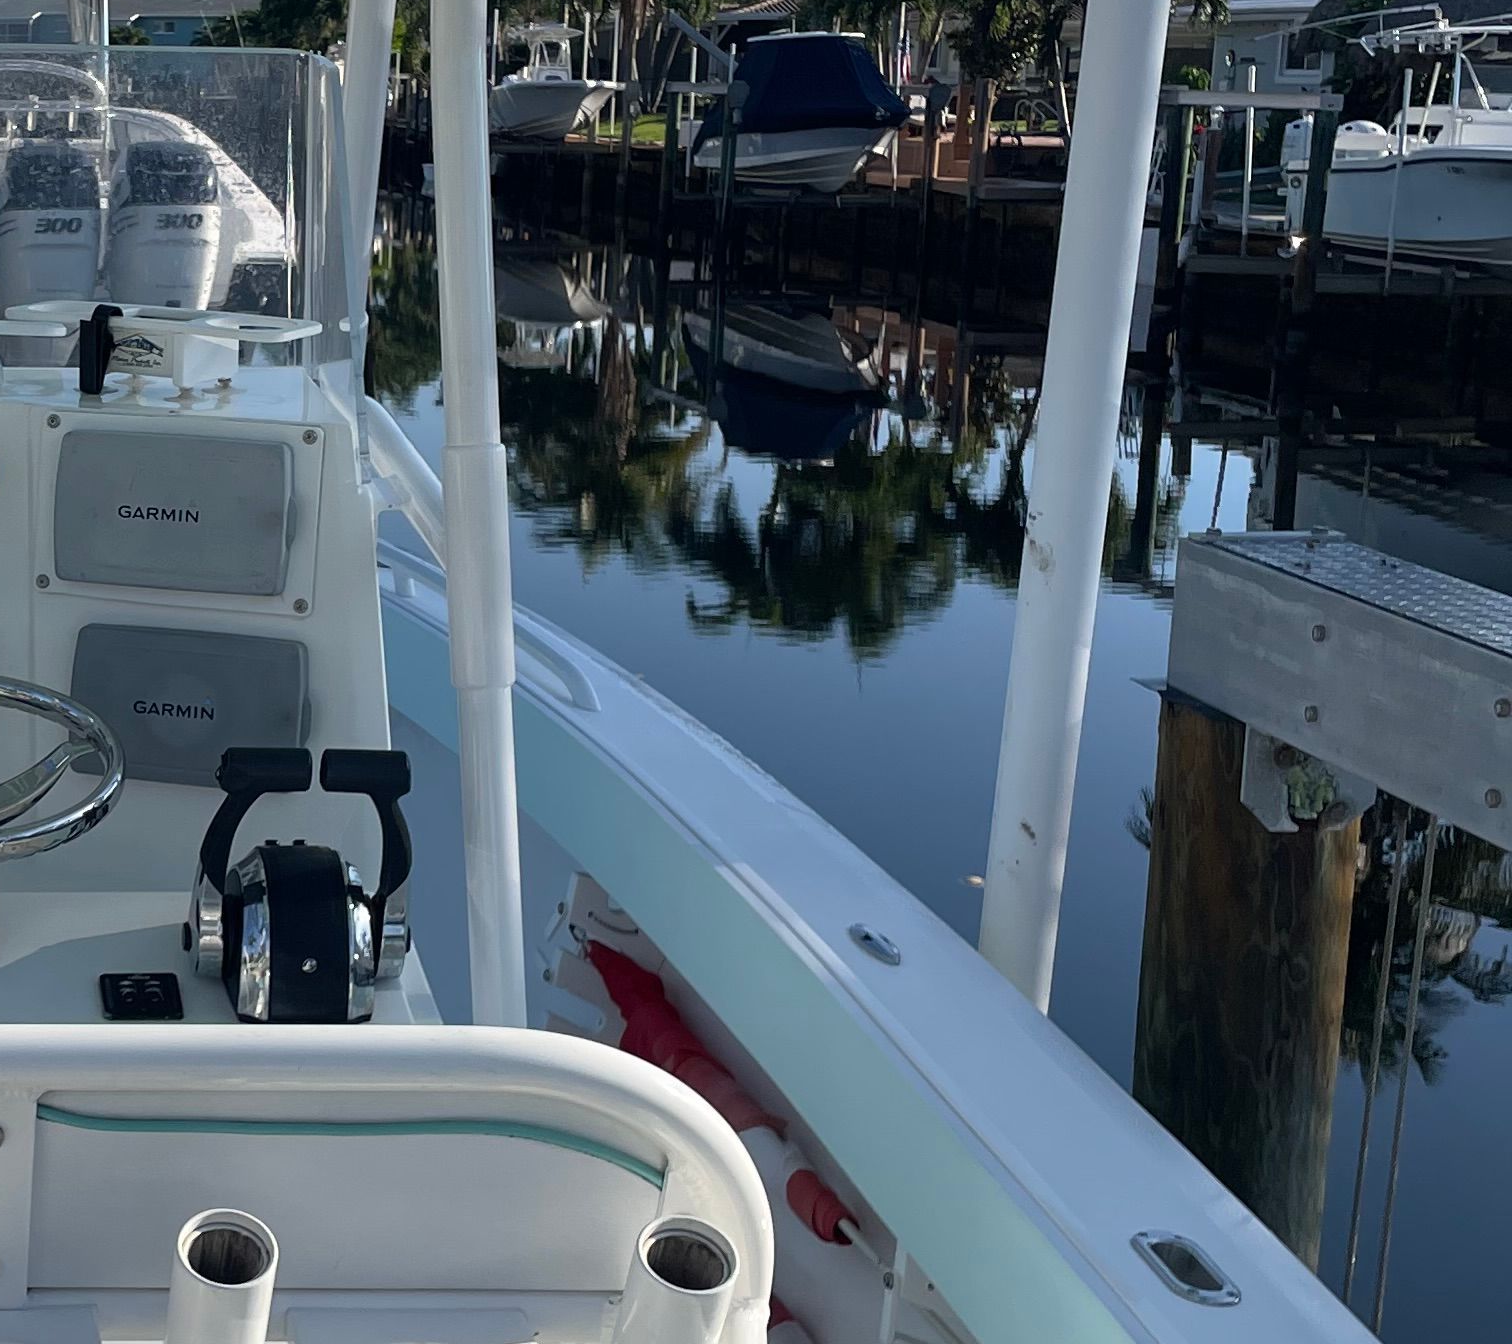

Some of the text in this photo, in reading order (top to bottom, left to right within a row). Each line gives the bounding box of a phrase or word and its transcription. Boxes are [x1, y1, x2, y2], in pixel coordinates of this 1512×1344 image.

[34, 216, 82, 234] 300
[155, 212, 203, 230] 300
[118, 505, 200, 523] GARMIN
[133, 700, 215, 720] GARMIN
